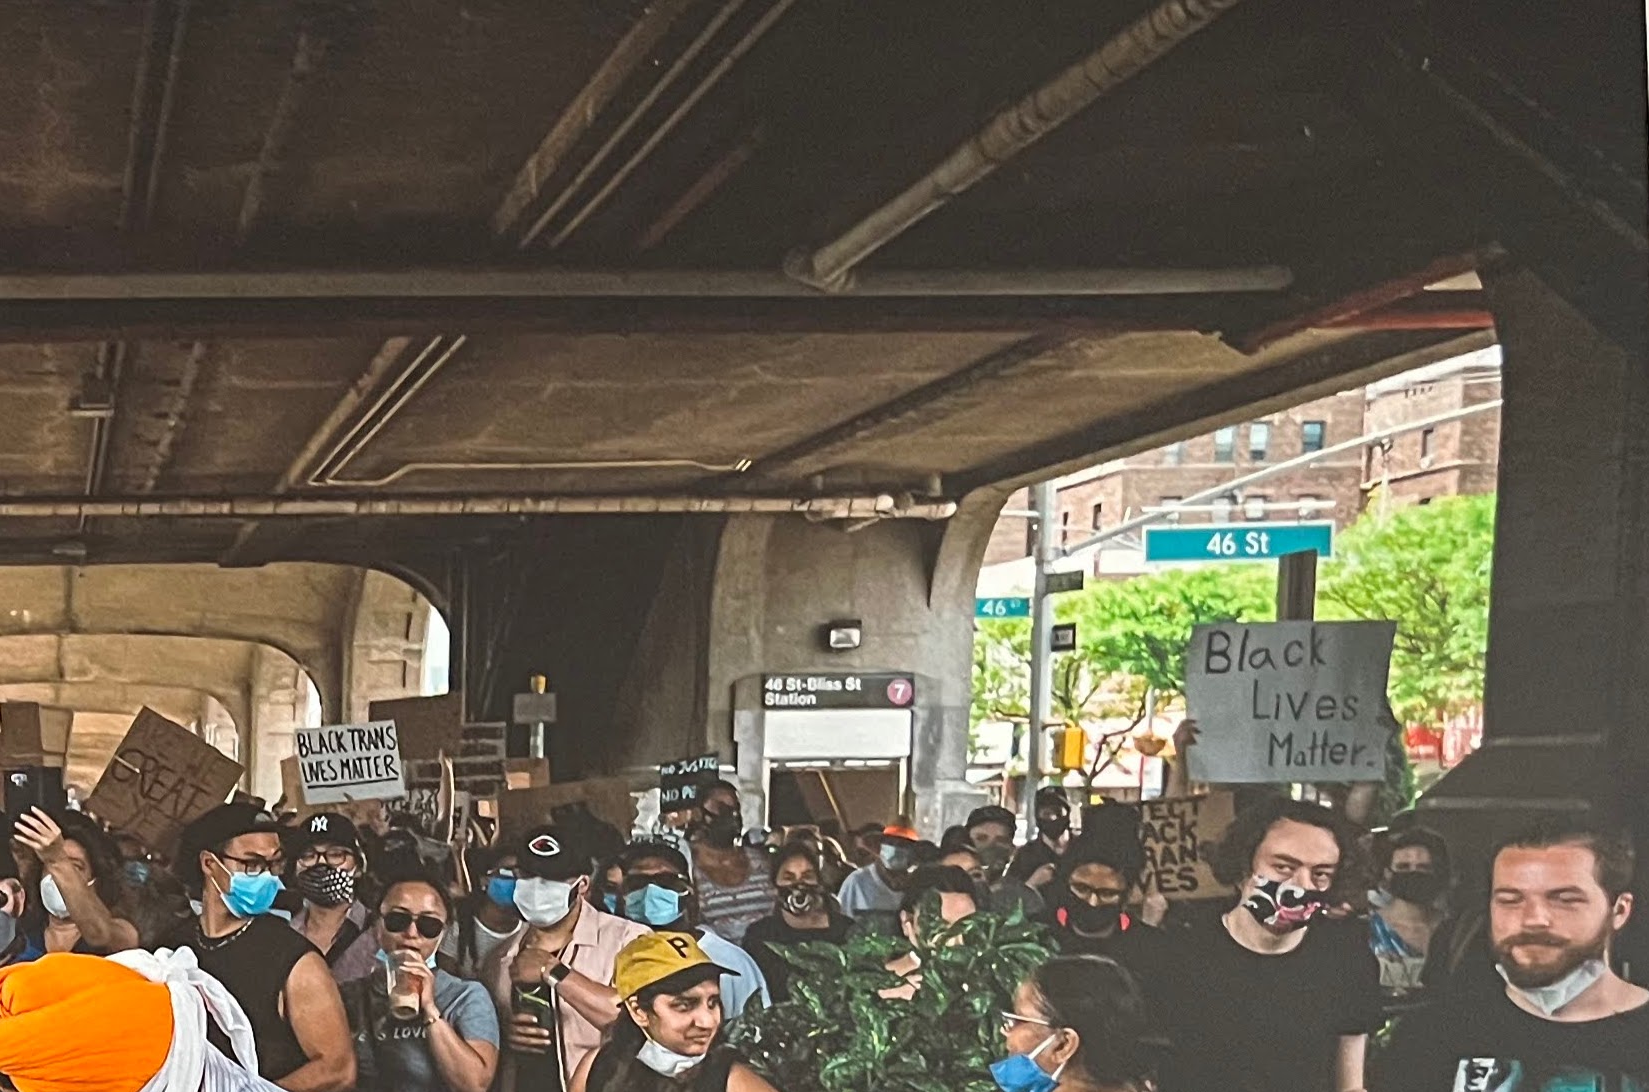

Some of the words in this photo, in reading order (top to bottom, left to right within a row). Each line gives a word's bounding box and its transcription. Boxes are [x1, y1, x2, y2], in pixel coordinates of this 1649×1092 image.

[1207, 532, 1236, 555] 46
[1245, 531, 1269, 555] St
[982, 599, 1007, 616] 46
[1205, 626, 1327, 675] Black
[765, 678, 782, 691] 46
[845, 677, 862, 691] St
[894, 684, 906, 699] 7
[765, 693, 817, 706] Station
[1252, 679, 1359, 721] Lives
[297, 730, 349, 758] BLACK
[347, 726, 397, 751] TRANS
[1268, 729, 1375, 767] Matter.
[302, 759, 337, 783] LIVES
[340, 754, 399, 780] MATTER
[1142, 820, 1198, 844] ACK
[1135, 867, 1199, 894] VES
[667, 936, 690, 959] P
